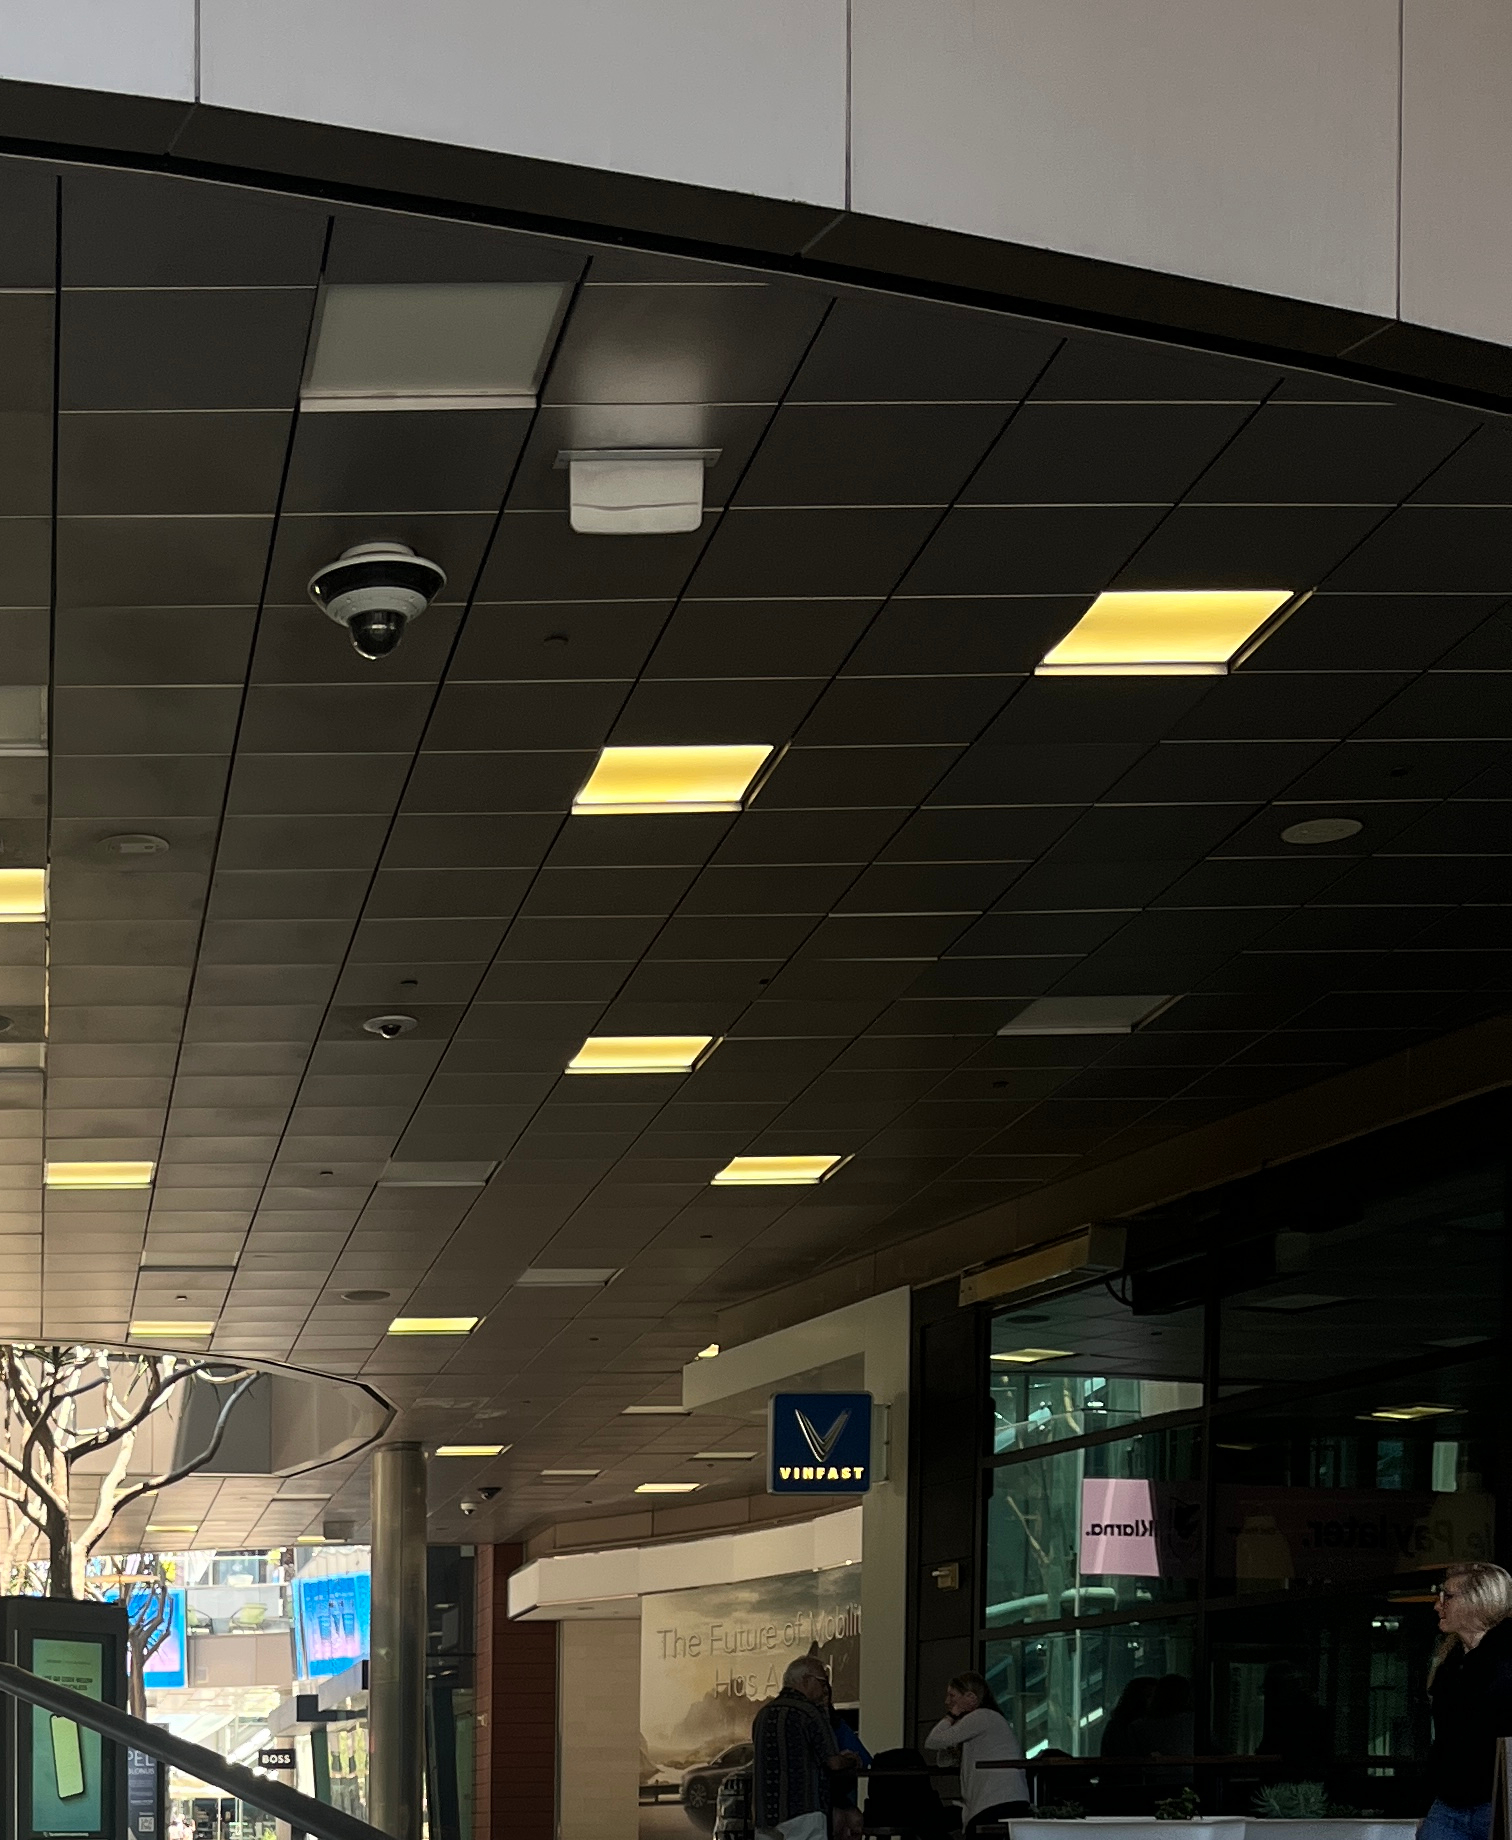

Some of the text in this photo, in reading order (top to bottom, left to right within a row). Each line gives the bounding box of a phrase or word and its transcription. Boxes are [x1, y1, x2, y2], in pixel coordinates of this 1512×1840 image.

[780, 1467, 864, 1480] VINFAST
[656, 1602, 862, 1660] The Future of Mobilit
[714, 1667, 758, 1698] Has
[128, 1750, 155, 1767] PEL
[261, 1754, 291, 1764] BOSS
